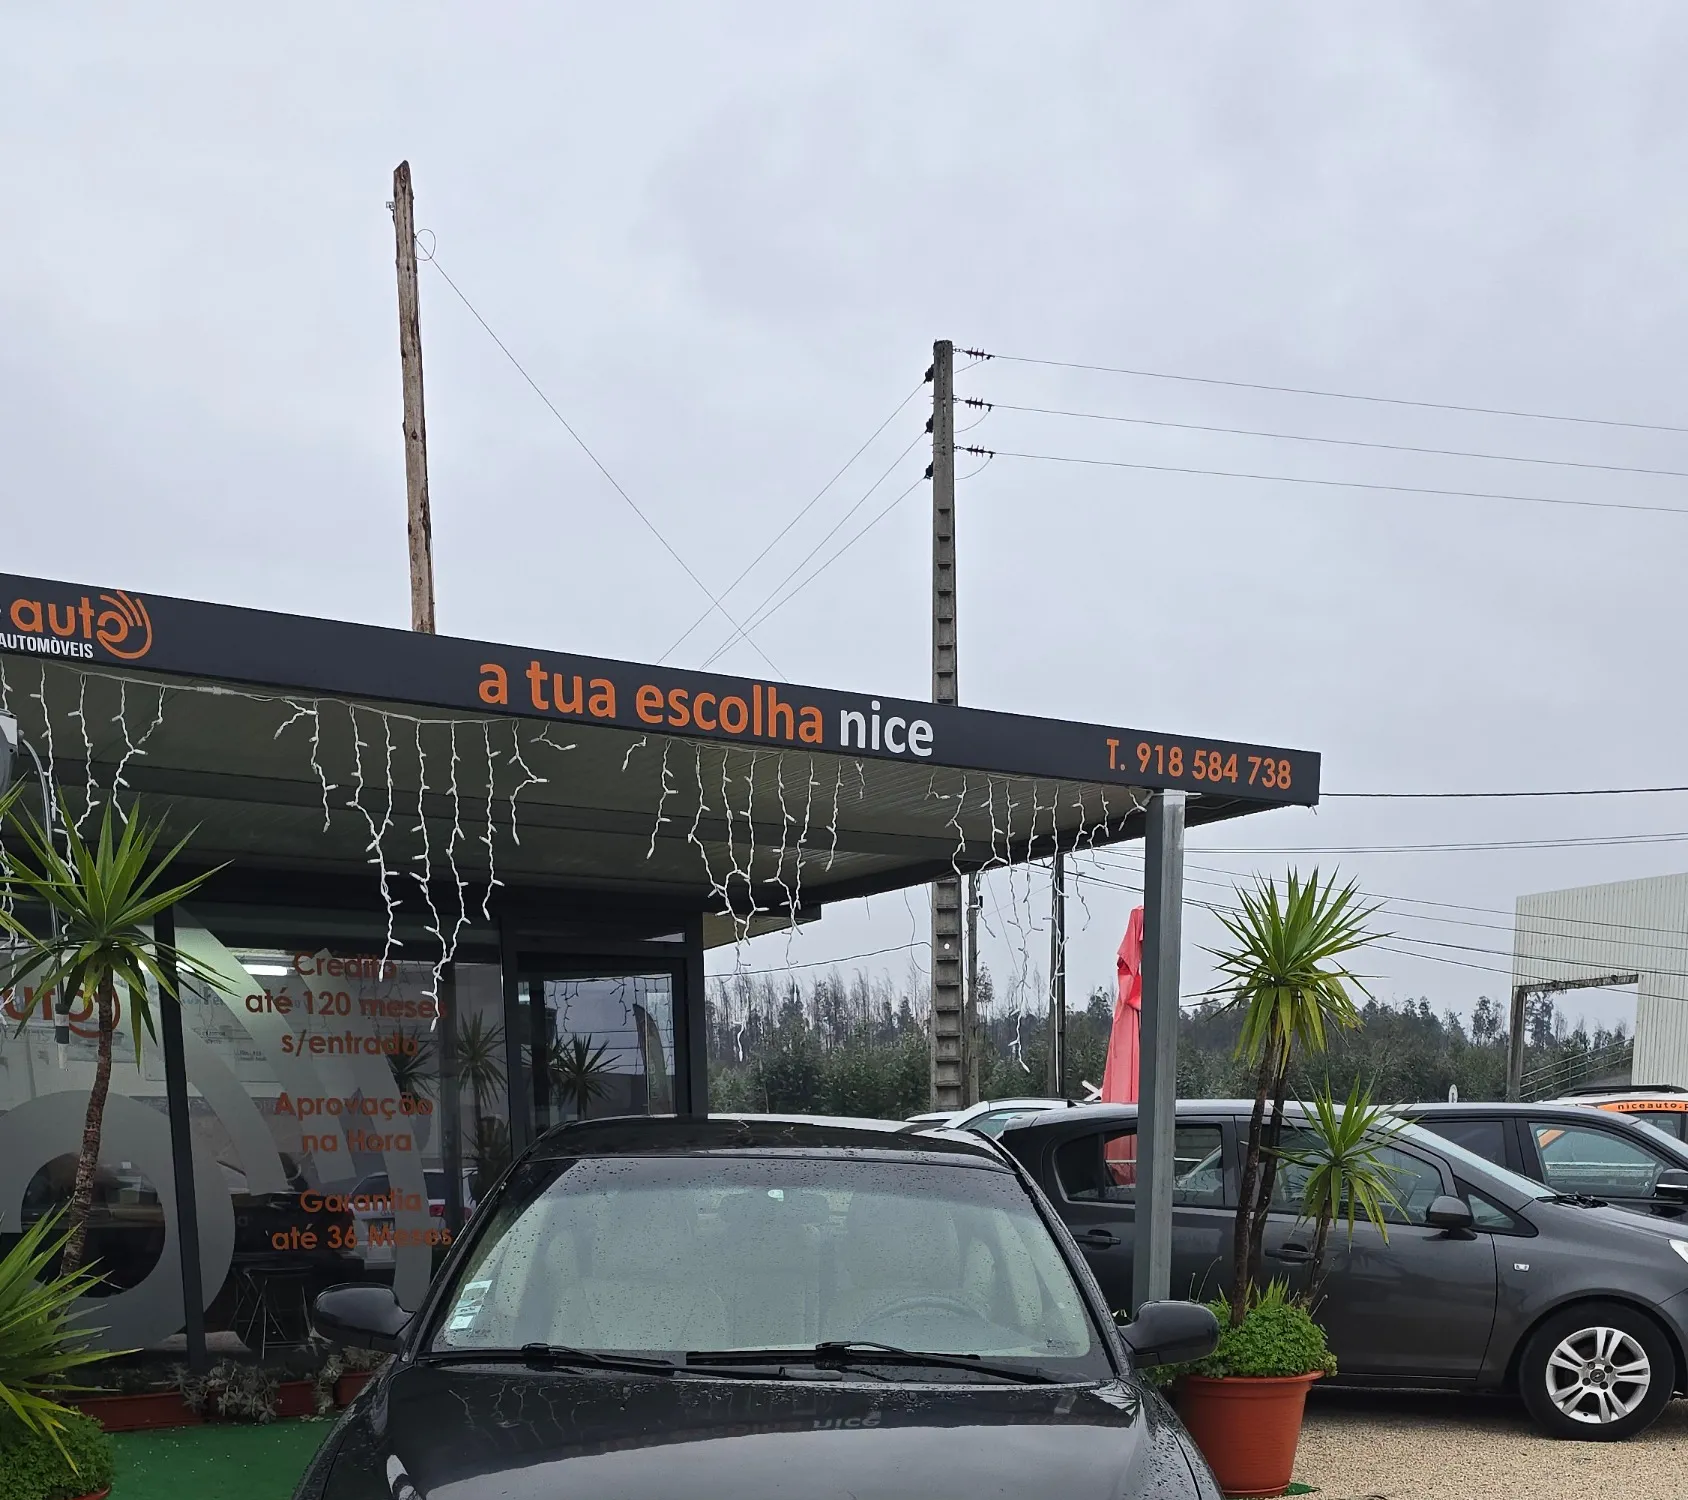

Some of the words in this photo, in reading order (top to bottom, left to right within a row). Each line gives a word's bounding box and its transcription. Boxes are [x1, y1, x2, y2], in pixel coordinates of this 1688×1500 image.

[478, 663, 508, 704] a
[525, 661, 616, 718] tua
[636, 685, 823, 743] escolha
[840, 701, 934, 756] nice
[1107, 738, 1125, 771] T.
[1136, 742, 1184, 777] 918
[1192, 750, 1238, 783] 584
[1247, 756, 1292, 790] 738
[245, 987, 293, 1014] até
[303, 991, 350, 1016] 120
[359, 999, 448, 1019] meses
[281, 1030, 419, 1057] s/entrada
[274, 1092, 433, 1121] Aprovação
[302, 1133, 338, 1152] na
[348, 1129, 414, 1152] Hora
[300, 1188, 422, 1213] Garantia
[271, 1223, 318, 1250] até
[327, 1224, 357, 1249] 36
[368, 1224, 453, 1248] Meses
